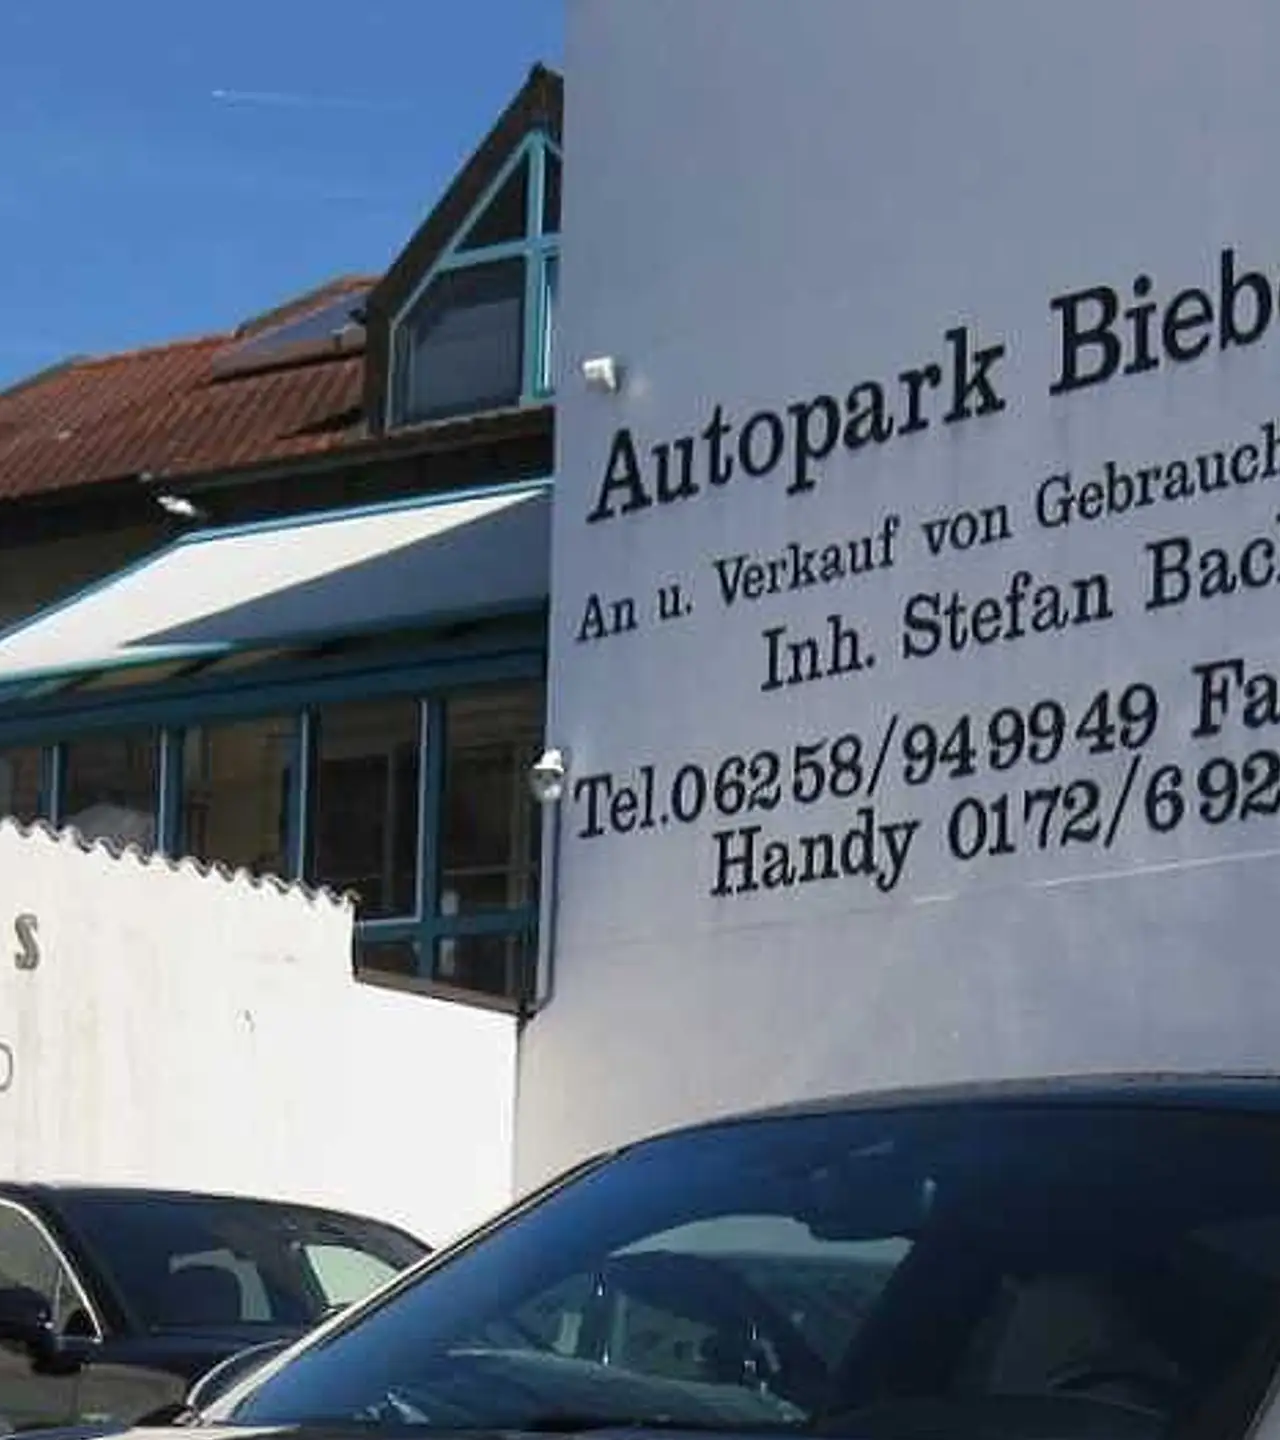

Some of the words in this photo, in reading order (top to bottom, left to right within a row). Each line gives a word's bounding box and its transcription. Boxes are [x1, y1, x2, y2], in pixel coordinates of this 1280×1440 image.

[586, 326, 1006, 524] Autopark
[576, 594, 638, 642] An
[657, 582, 694, 621] u.
[714, 516, 900, 607] Verkauf
[922, 503, 1011, 556] von
[760, 614, 875, 692] Inh.
[902, 571, 1114, 660] Stefan
[710, 806, 920, 897] Handy
